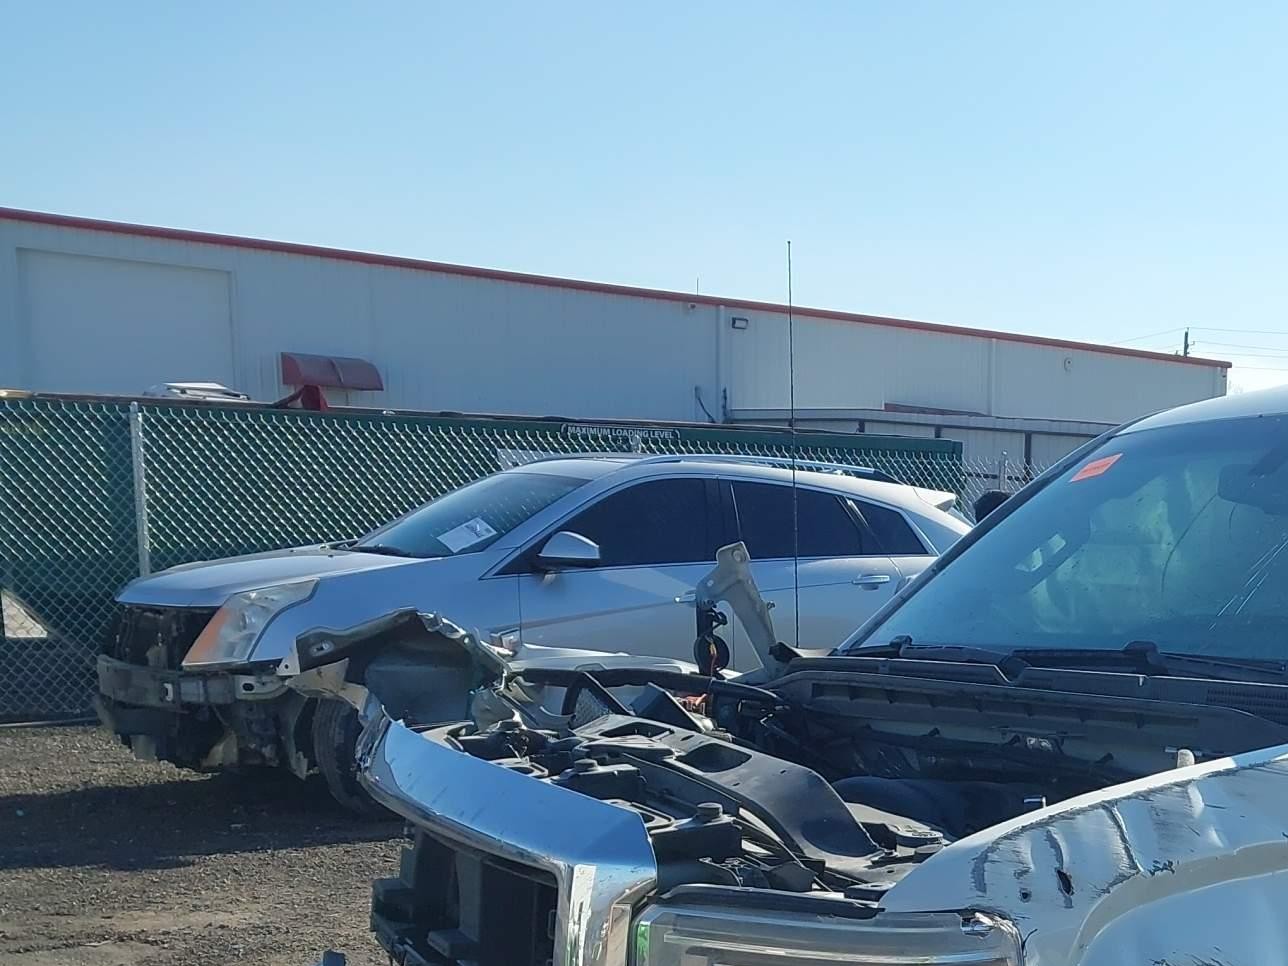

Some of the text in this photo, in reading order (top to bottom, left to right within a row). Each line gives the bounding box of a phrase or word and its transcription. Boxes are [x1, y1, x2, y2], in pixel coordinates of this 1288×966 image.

[567, 426, 674, 439] MAXIMUM LOADING LEVEL
